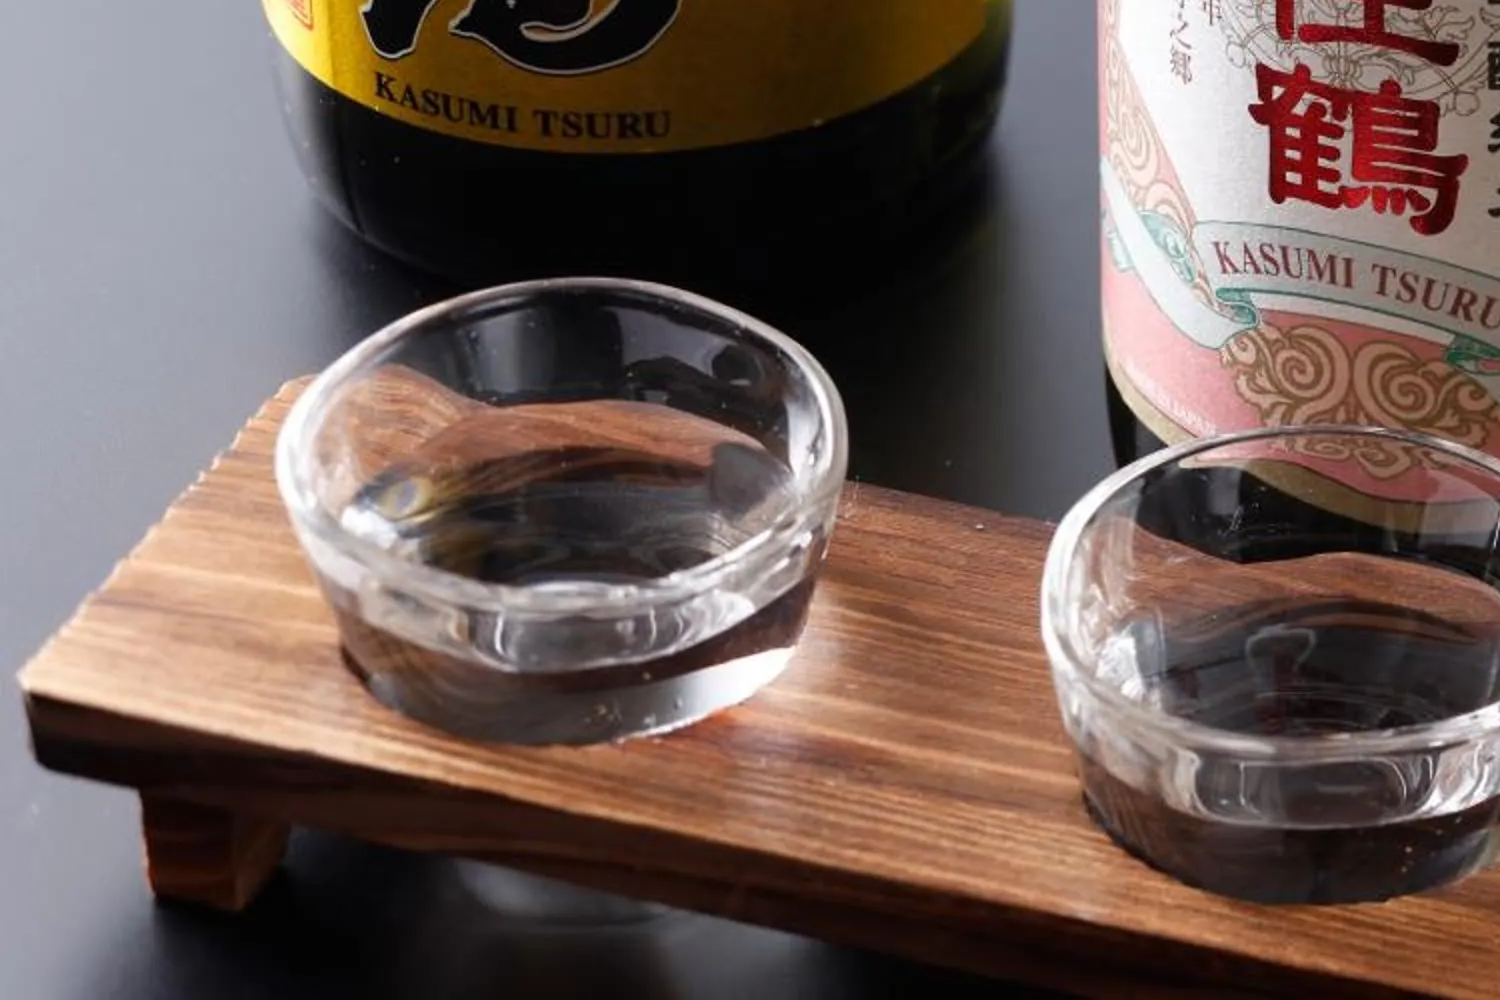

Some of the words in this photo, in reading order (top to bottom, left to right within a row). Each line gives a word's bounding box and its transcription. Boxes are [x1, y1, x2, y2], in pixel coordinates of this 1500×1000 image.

[374, 71, 518, 133] KASUMI
[532, 108, 671, 139] TSURU
[1211, 240, 1355, 290] KASUMI
